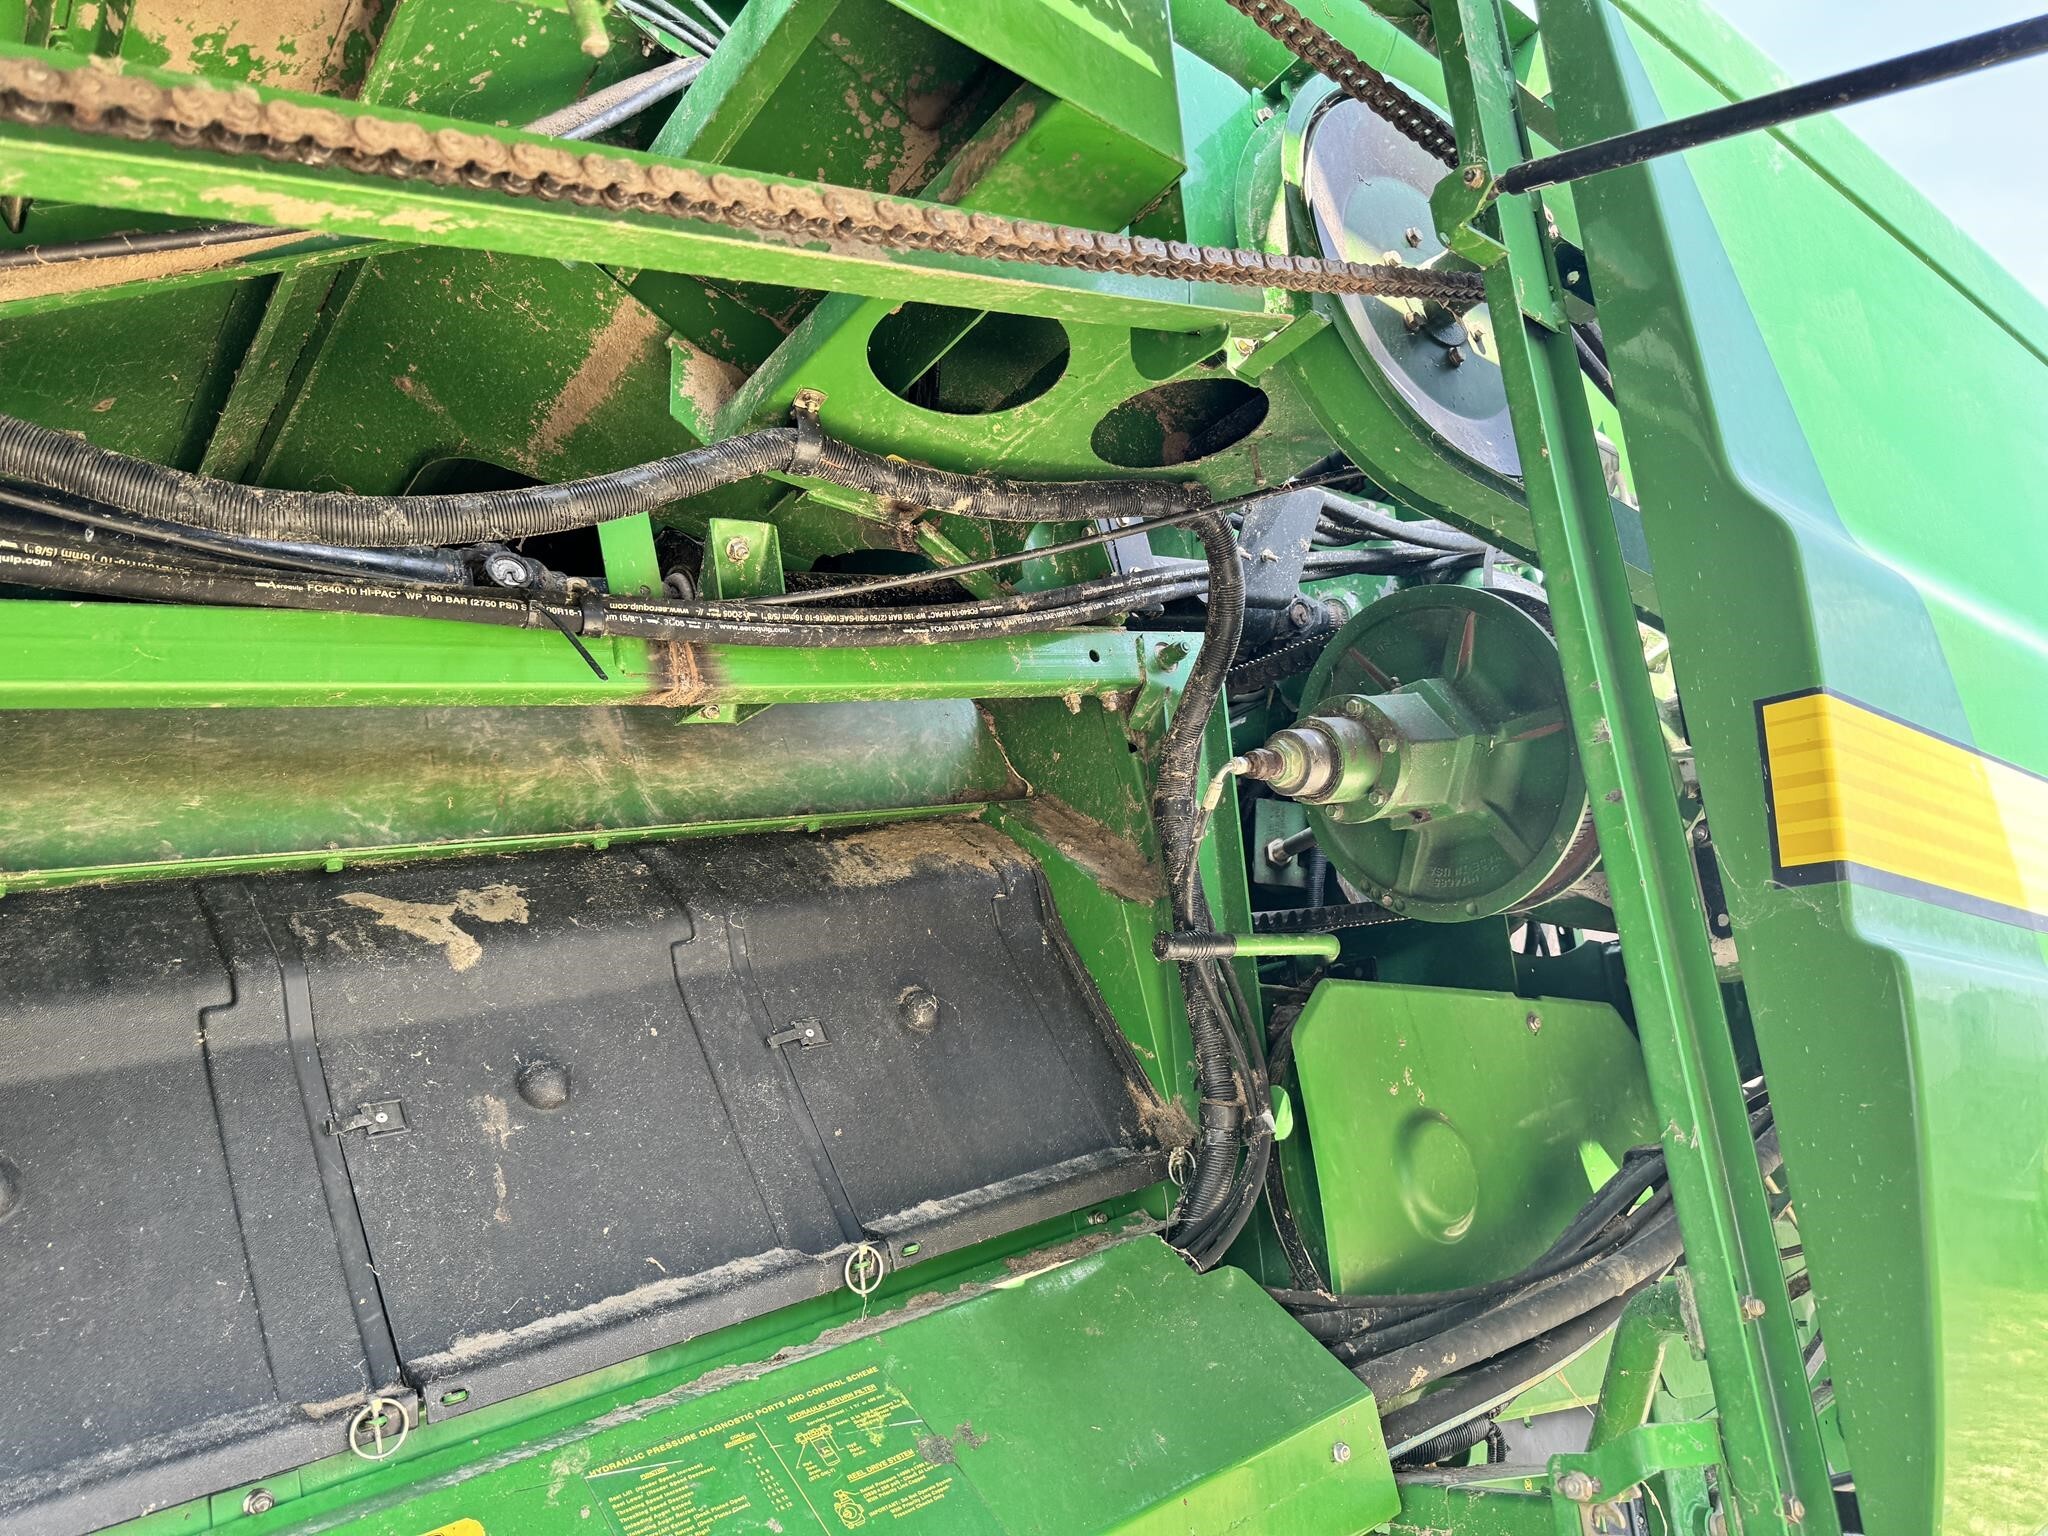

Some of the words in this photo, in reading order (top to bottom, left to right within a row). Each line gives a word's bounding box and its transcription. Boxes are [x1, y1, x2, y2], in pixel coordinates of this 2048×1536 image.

[0, 554, 53, 567] uip.com
[307, 584, 357, 595] FC640-10
[405, 592, 422, 601] WP
[425, 594, 443, 603] 190
[445, 596, 468, 606] BAR
[470, 598, 497, 608] (2750
[609, 602, 689, 615] www.aeroquip.com
[719, 623, 790, 635] www.aeroquip.com
[787, 1403, 827, 1422] HYDRAULIC
[827, 1393, 854, 1407] RETURN
[854, 1384, 877, 1396] FILTER
[588, 1452, 645, 1477] HYDRAULIC
[646, 1433, 698, 1456] PRESSURE
[699, 1412, 755, 1437] DIAGNOSTIC
[755, 1401, 785, 1416] PORTS
[786, 1393, 806, 1405] AND
[806, 1379, 846, 1397] CONTROL
[846, 1366, 879, 1382] SCHEME
[847, 1469, 867, 1481] REEL
[866, 1460, 889, 1473] DRIVE
[887, 1449, 916, 1465] SYSTEM
[645, 1494, 664, 1505] Speed
[671, 1500, 692, 1511] Extend
[649, 1501, 668, 1512] Speed
